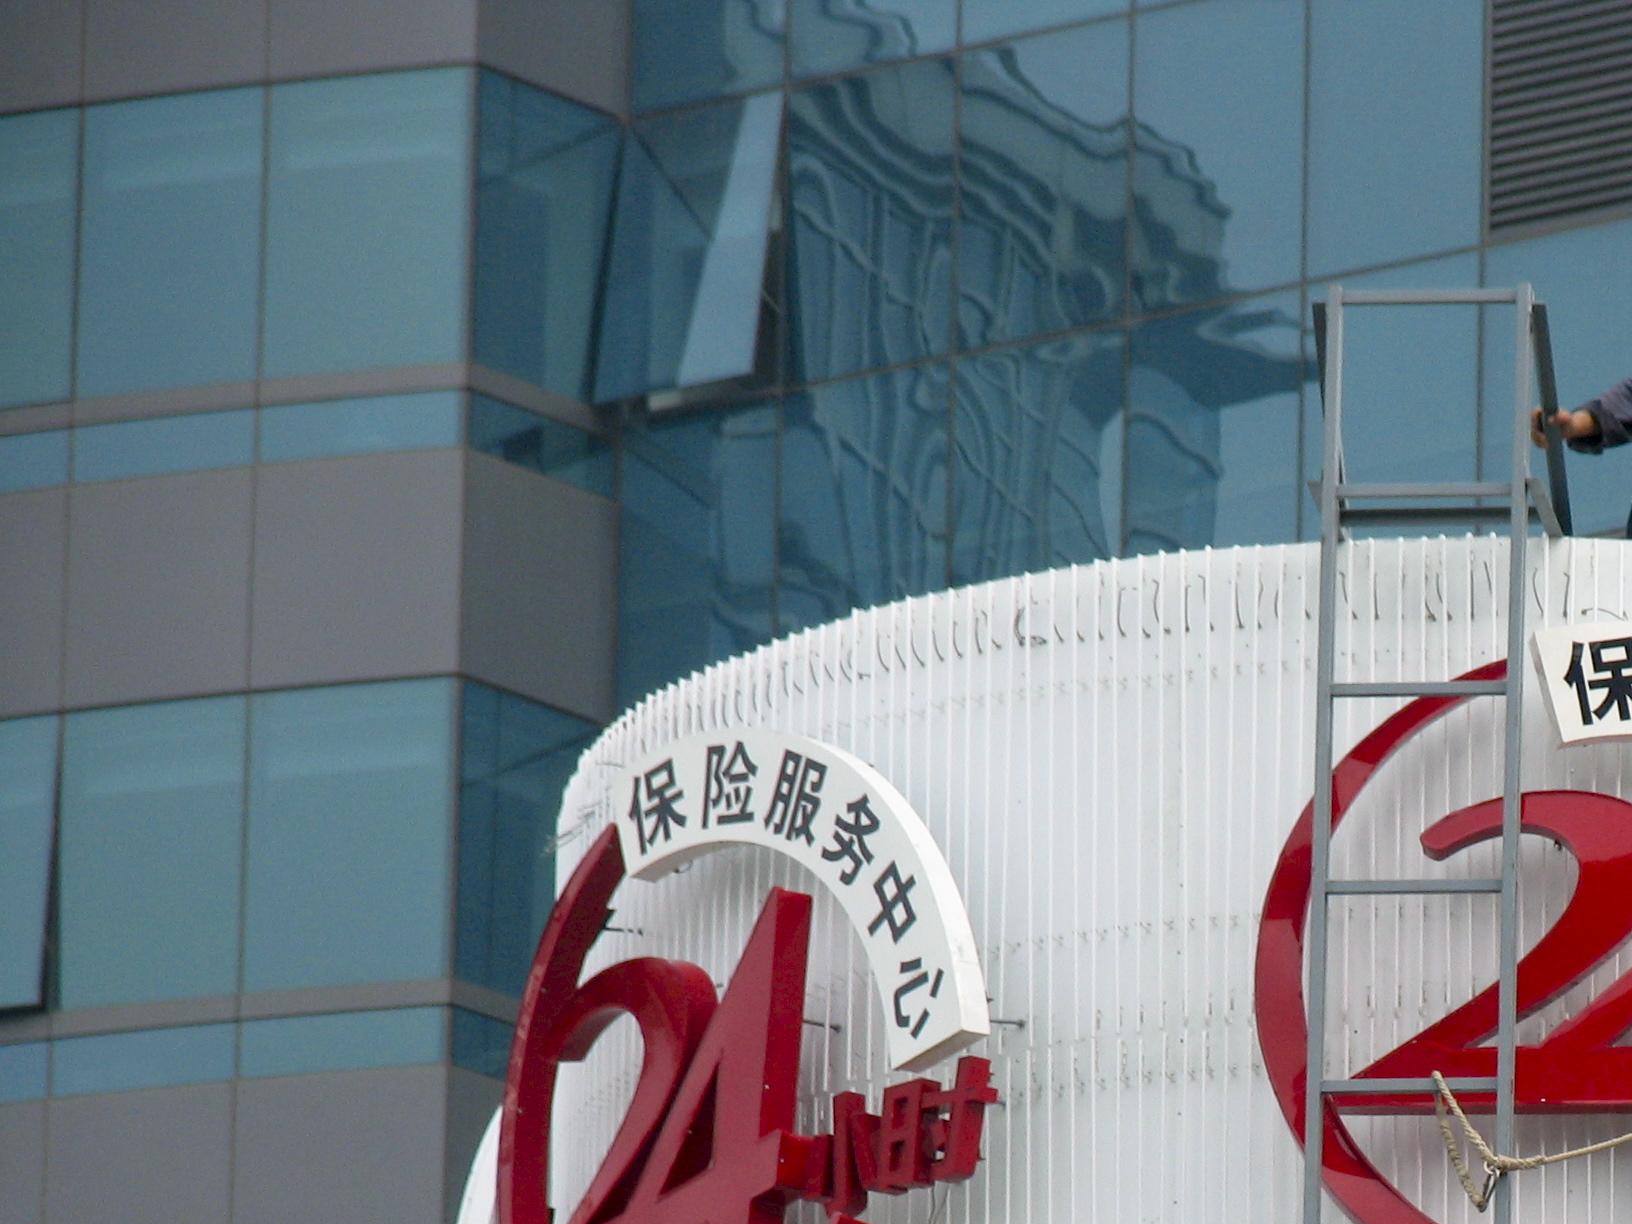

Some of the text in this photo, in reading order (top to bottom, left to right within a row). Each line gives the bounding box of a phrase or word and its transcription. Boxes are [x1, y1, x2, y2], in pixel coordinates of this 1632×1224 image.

[627, 740, 944, 1040] 保险服务中心
